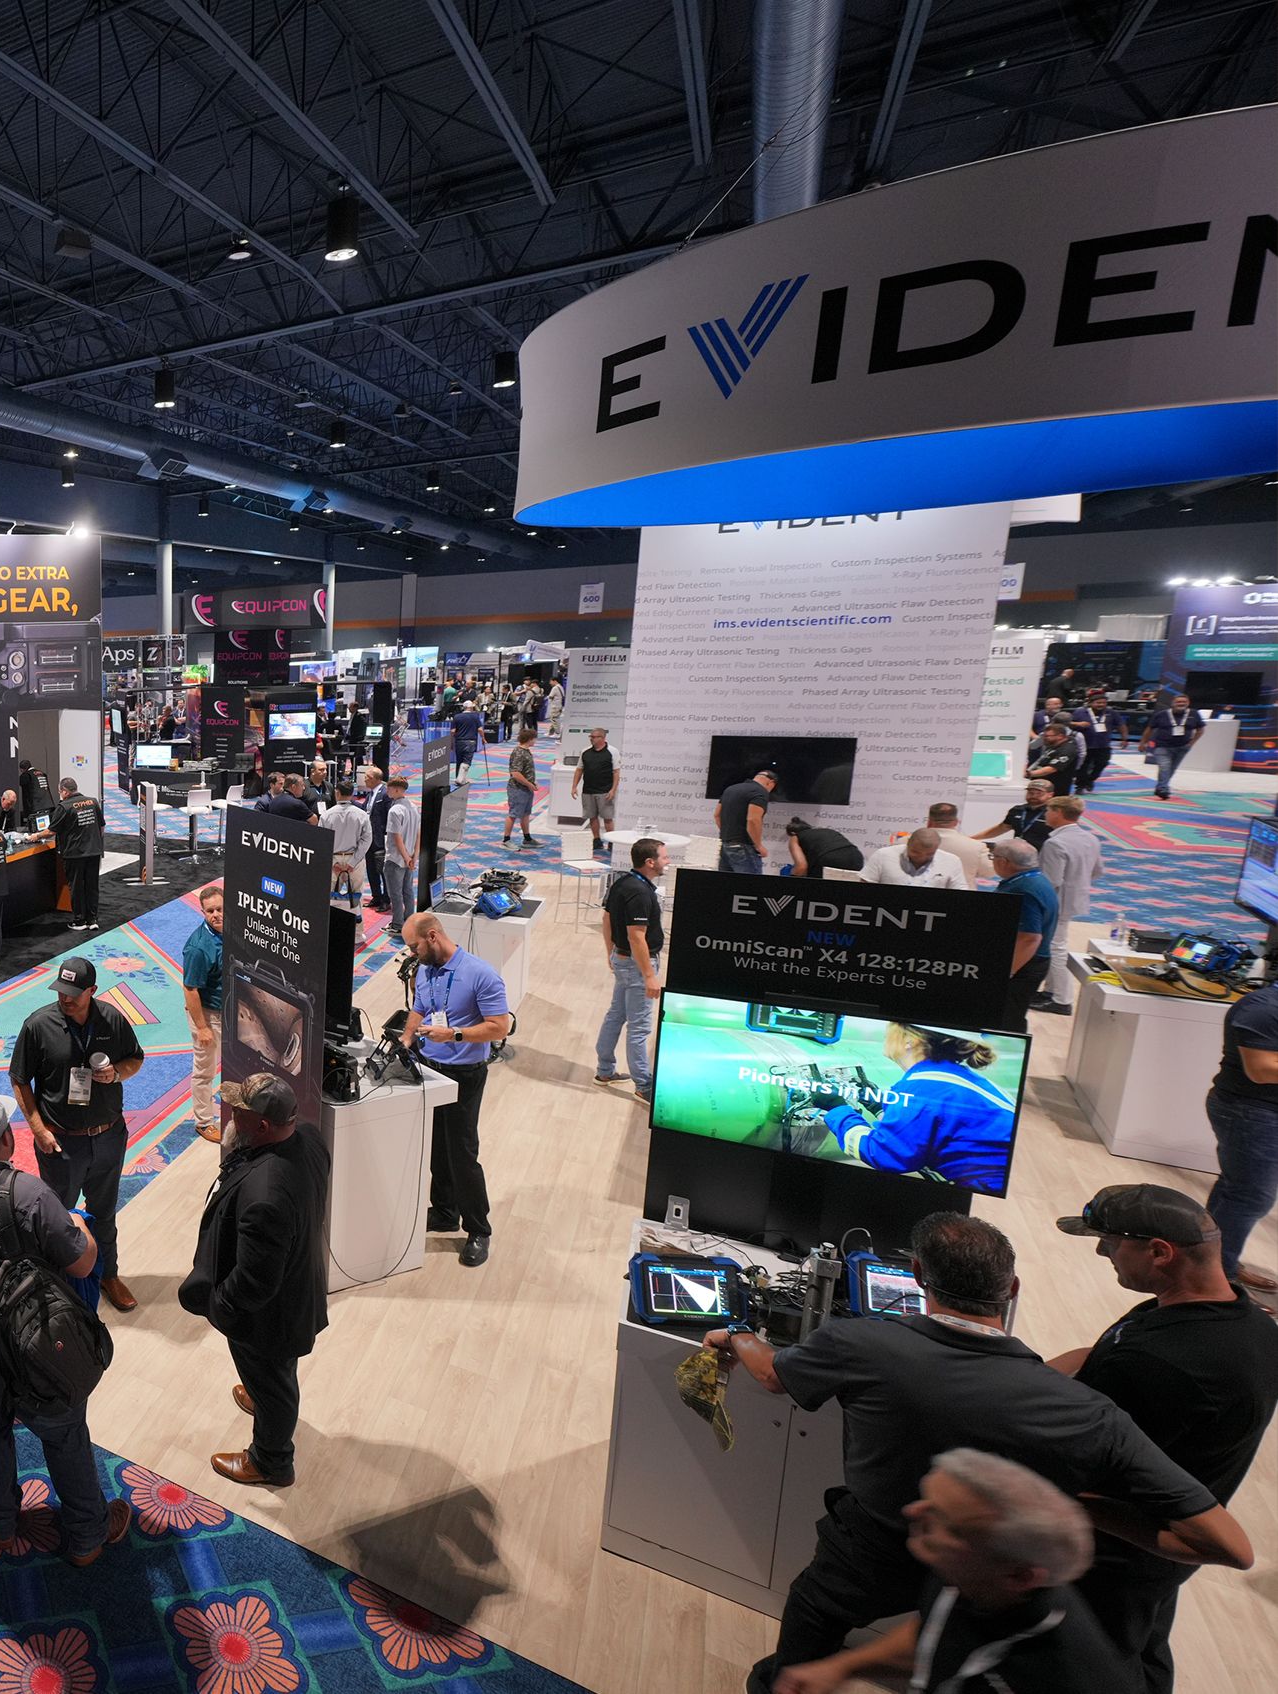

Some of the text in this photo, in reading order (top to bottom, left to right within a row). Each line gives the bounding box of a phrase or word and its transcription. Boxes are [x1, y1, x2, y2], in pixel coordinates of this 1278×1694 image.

[830, 559, 871, 568] Custom
[874, 554, 932, 566] Inspection
[934, 551, 983, 563] Systems
[17, 566, 69, 580] EXTRA
[677, 580, 722, 589] Detection
[717, 593, 751, 602] Testing
[844, 601, 897, 610] Ultrasonic
[901, 599, 927, 608] Flaw
[929, 597, 984, 607] Detection
[231, 600, 307, 615] EQUIPCON
[713, 615, 892, 629] ims.evidentscientific.com
[217, 652, 262, 661] EQUIPCON
[637, 649, 669, 657] Phased
[671, 649, 694, 658] Array
[697, 648, 742, 656] Ultrasonic
[745, 648, 780, 657] Testing
[991, 646, 1024, 655] FILM
[582, 654, 627, 663] FUJIFILM
[814, 658, 950, 668] Advanced Ultrasonic Flaw
[689, 675, 723, 683] Custom
[725, 675, 775, 684] Inspection
[778, 675, 818, 683] Systems
[983, 676, 1024, 685] Tested
[802, 687, 971, 697] Phased Array Ultrasonic Testing
[642, 713, 755, 723] Ultrasonic Flaw Detection
[241, 830, 314, 865] EVIDENT
[264, 880, 283, 895] NEW
[237, 890, 310, 934] IPLEX™ One
[731, 894, 947, 932] EVIDENT
[247, 916, 298, 948] Unleash The
[806, 930, 857, 947] NEW
[244, 929, 301, 964] Power of One
[695, 935, 979, 980] OmniScan™ X4 128:128PR
[733, 956, 927, 990] What the Experts Use
[738, 1066, 914, 1108] Pioneers in NDT
